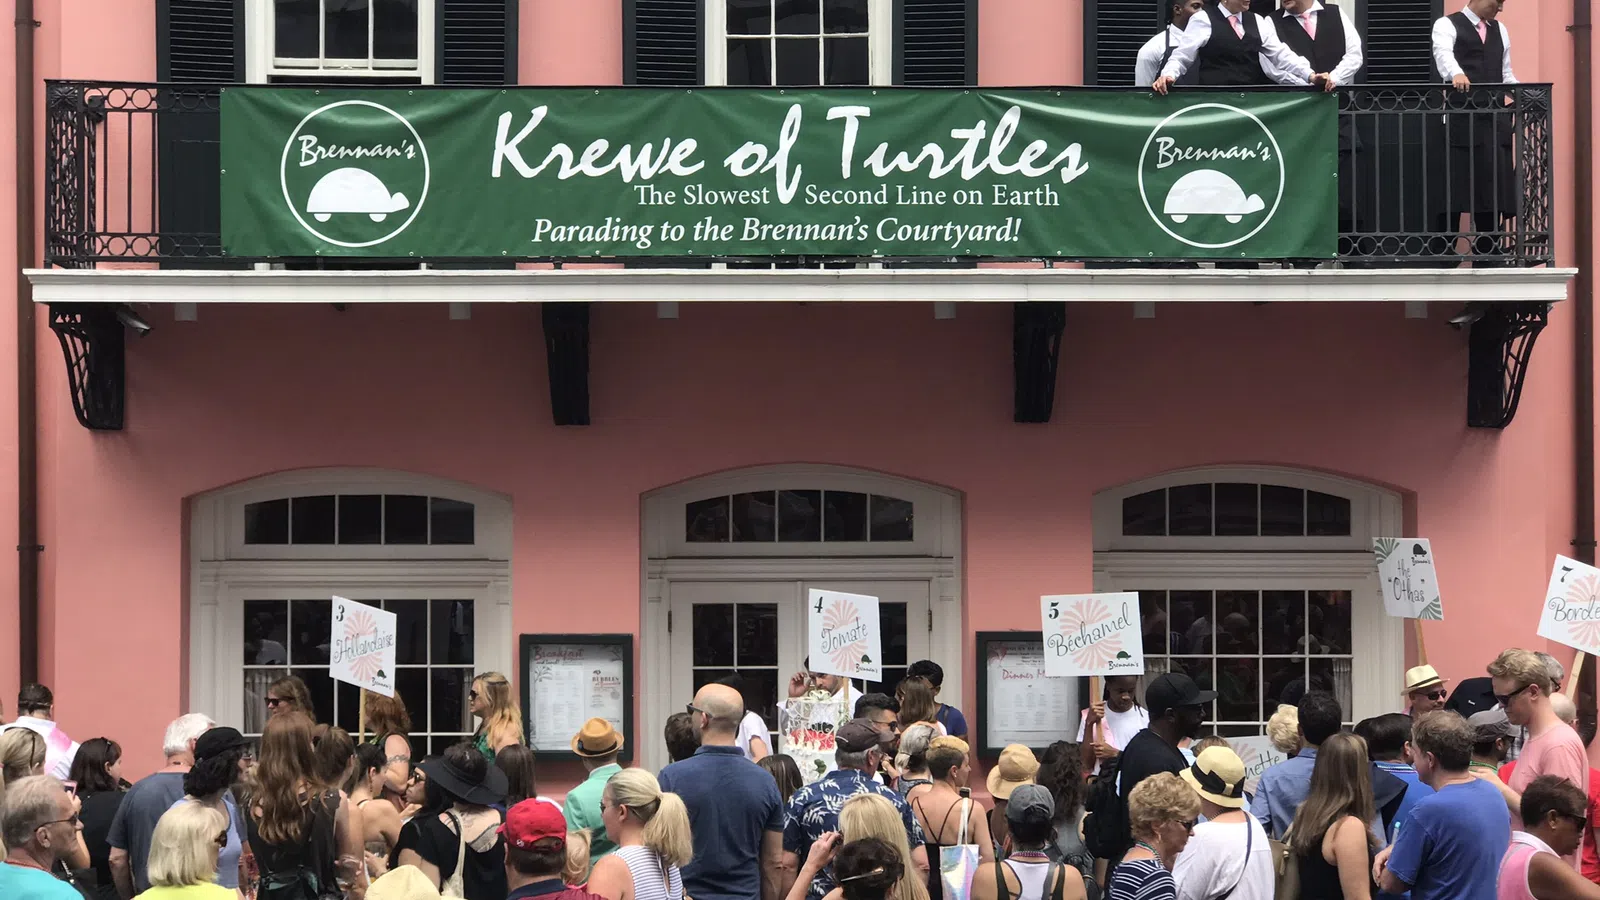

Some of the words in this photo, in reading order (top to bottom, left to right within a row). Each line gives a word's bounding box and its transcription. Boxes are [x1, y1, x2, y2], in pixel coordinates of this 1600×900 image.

[298, 134, 416, 167] Brennan's
[491, 104, 705, 183] Krewe
[723, 103, 802, 205] of
[825, 105, 1089, 184] Turtles
[1155, 136, 1271, 169] Brennan's
[634, 184, 676, 205] The
[683, 183, 770, 206] Slowest
[804, 183, 888, 206] Second
[896, 185, 947, 206] Line
[952, 189, 984, 206] on
[991, 184, 1060, 206] Earth
[531, 216, 655, 249] Parading
[660, 220, 685, 243] to
[692, 216, 734, 243] the
[740, 215, 869, 243] Brennan's
[875, 217, 1022, 249] Courtyard!
[1397, 558, 1411, 579] the
[1560, 565, 1574, 583] 7
[336, 604, 345, 622] 3
[814, 596, 824, 613] 4
[1048, 601, 1060, 620] 5
[821, 616, 869, 654] Tomate
[1047, 602, 1133, 657] Béchamel
[333, 626, 394, 664] Hollandaise
[1002, 668, 1034, 680] Dinner
[1108, 660, 1139, 671] Brennan's
